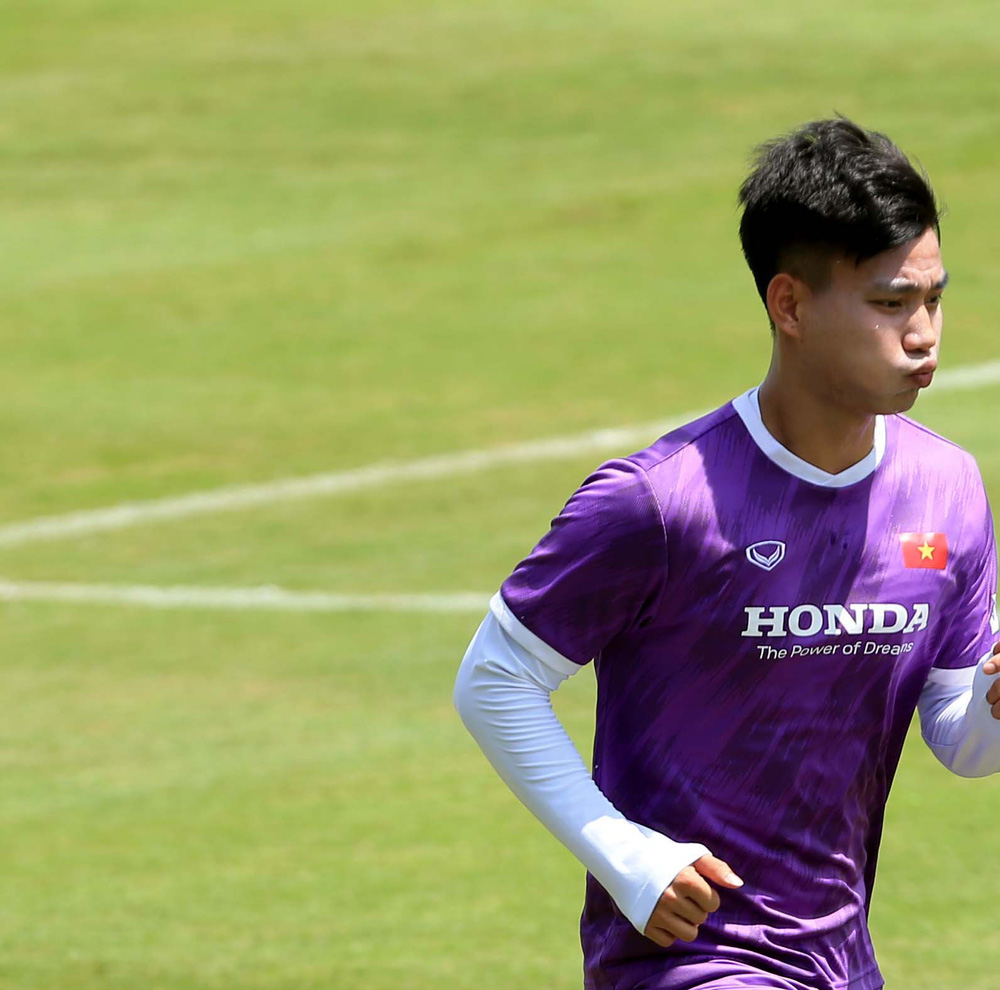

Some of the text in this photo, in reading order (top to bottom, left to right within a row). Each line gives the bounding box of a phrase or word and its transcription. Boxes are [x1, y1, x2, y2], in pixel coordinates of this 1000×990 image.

[741, 603, 930, 637] HONDA
[757, 645, 788, 660] The
[790, 644, 841, 658] Power
[842, 641, 862, 655] of
